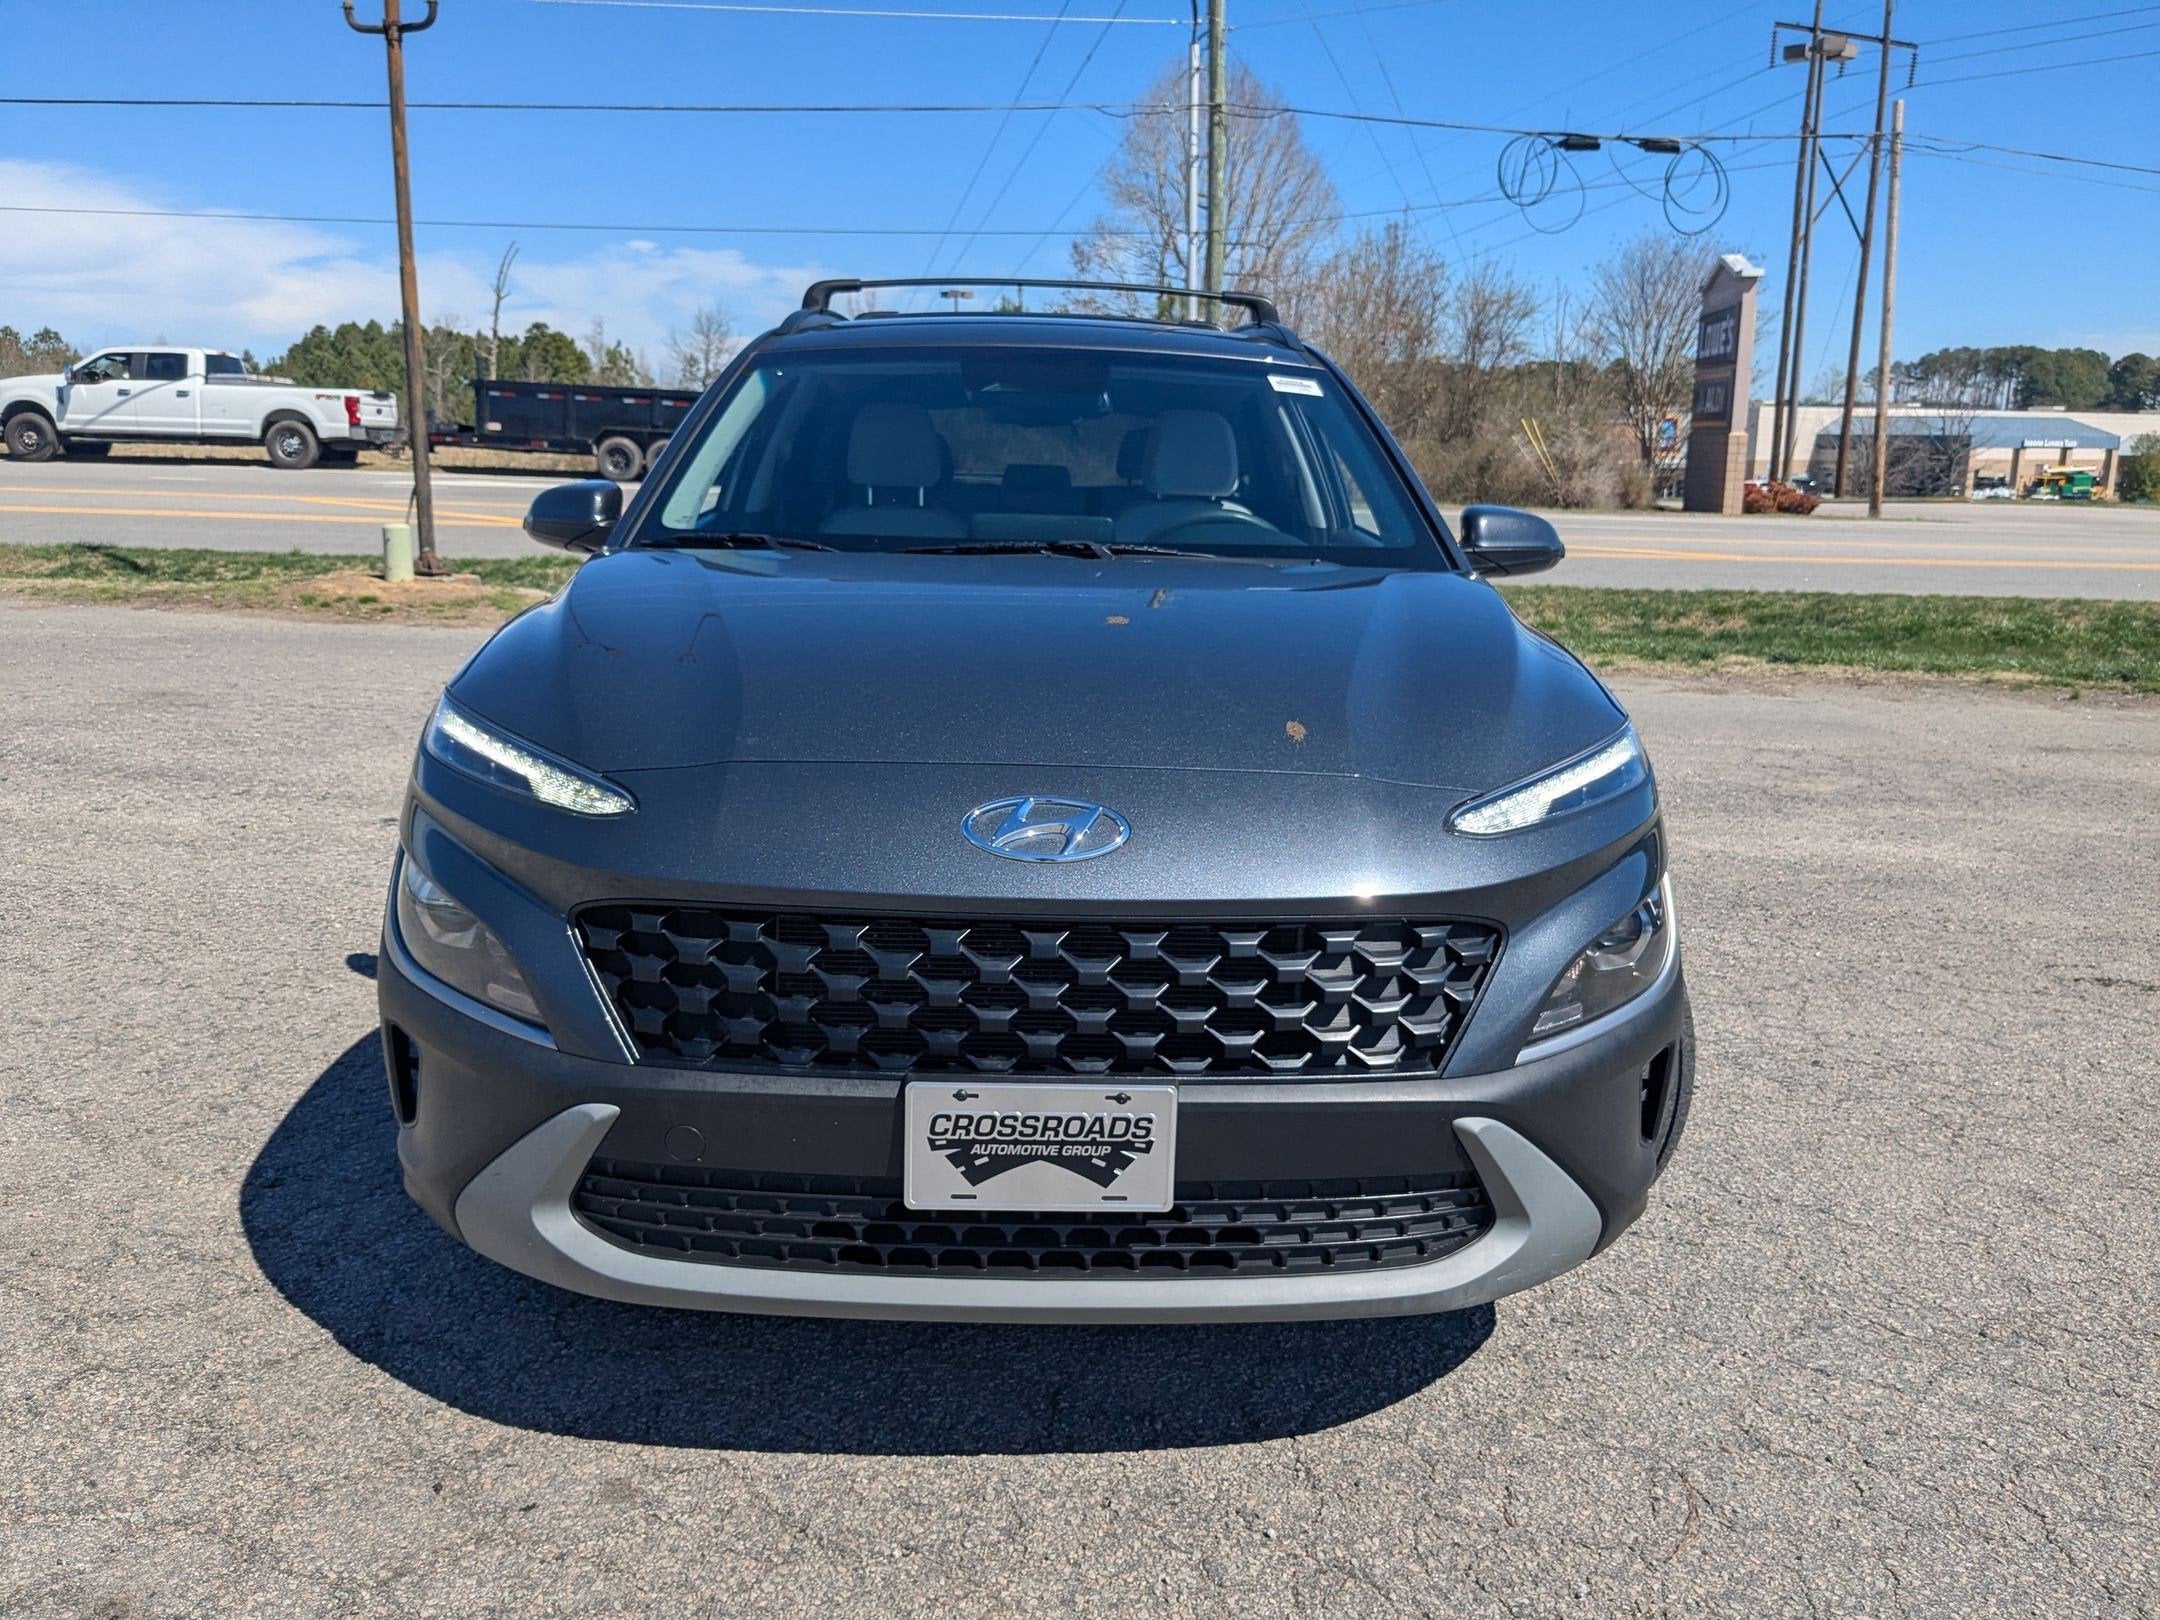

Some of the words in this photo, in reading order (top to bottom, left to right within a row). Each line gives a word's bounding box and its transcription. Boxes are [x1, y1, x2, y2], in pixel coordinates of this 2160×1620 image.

[1699, 314, 1734, 358] LOWE'S
[928, 1113, 1153, 1140] CROSSROADS
[970, 1143, 1062, 1157] AUTOMOTIVE
[1063, 1144, 1111, 1158] GROUP
